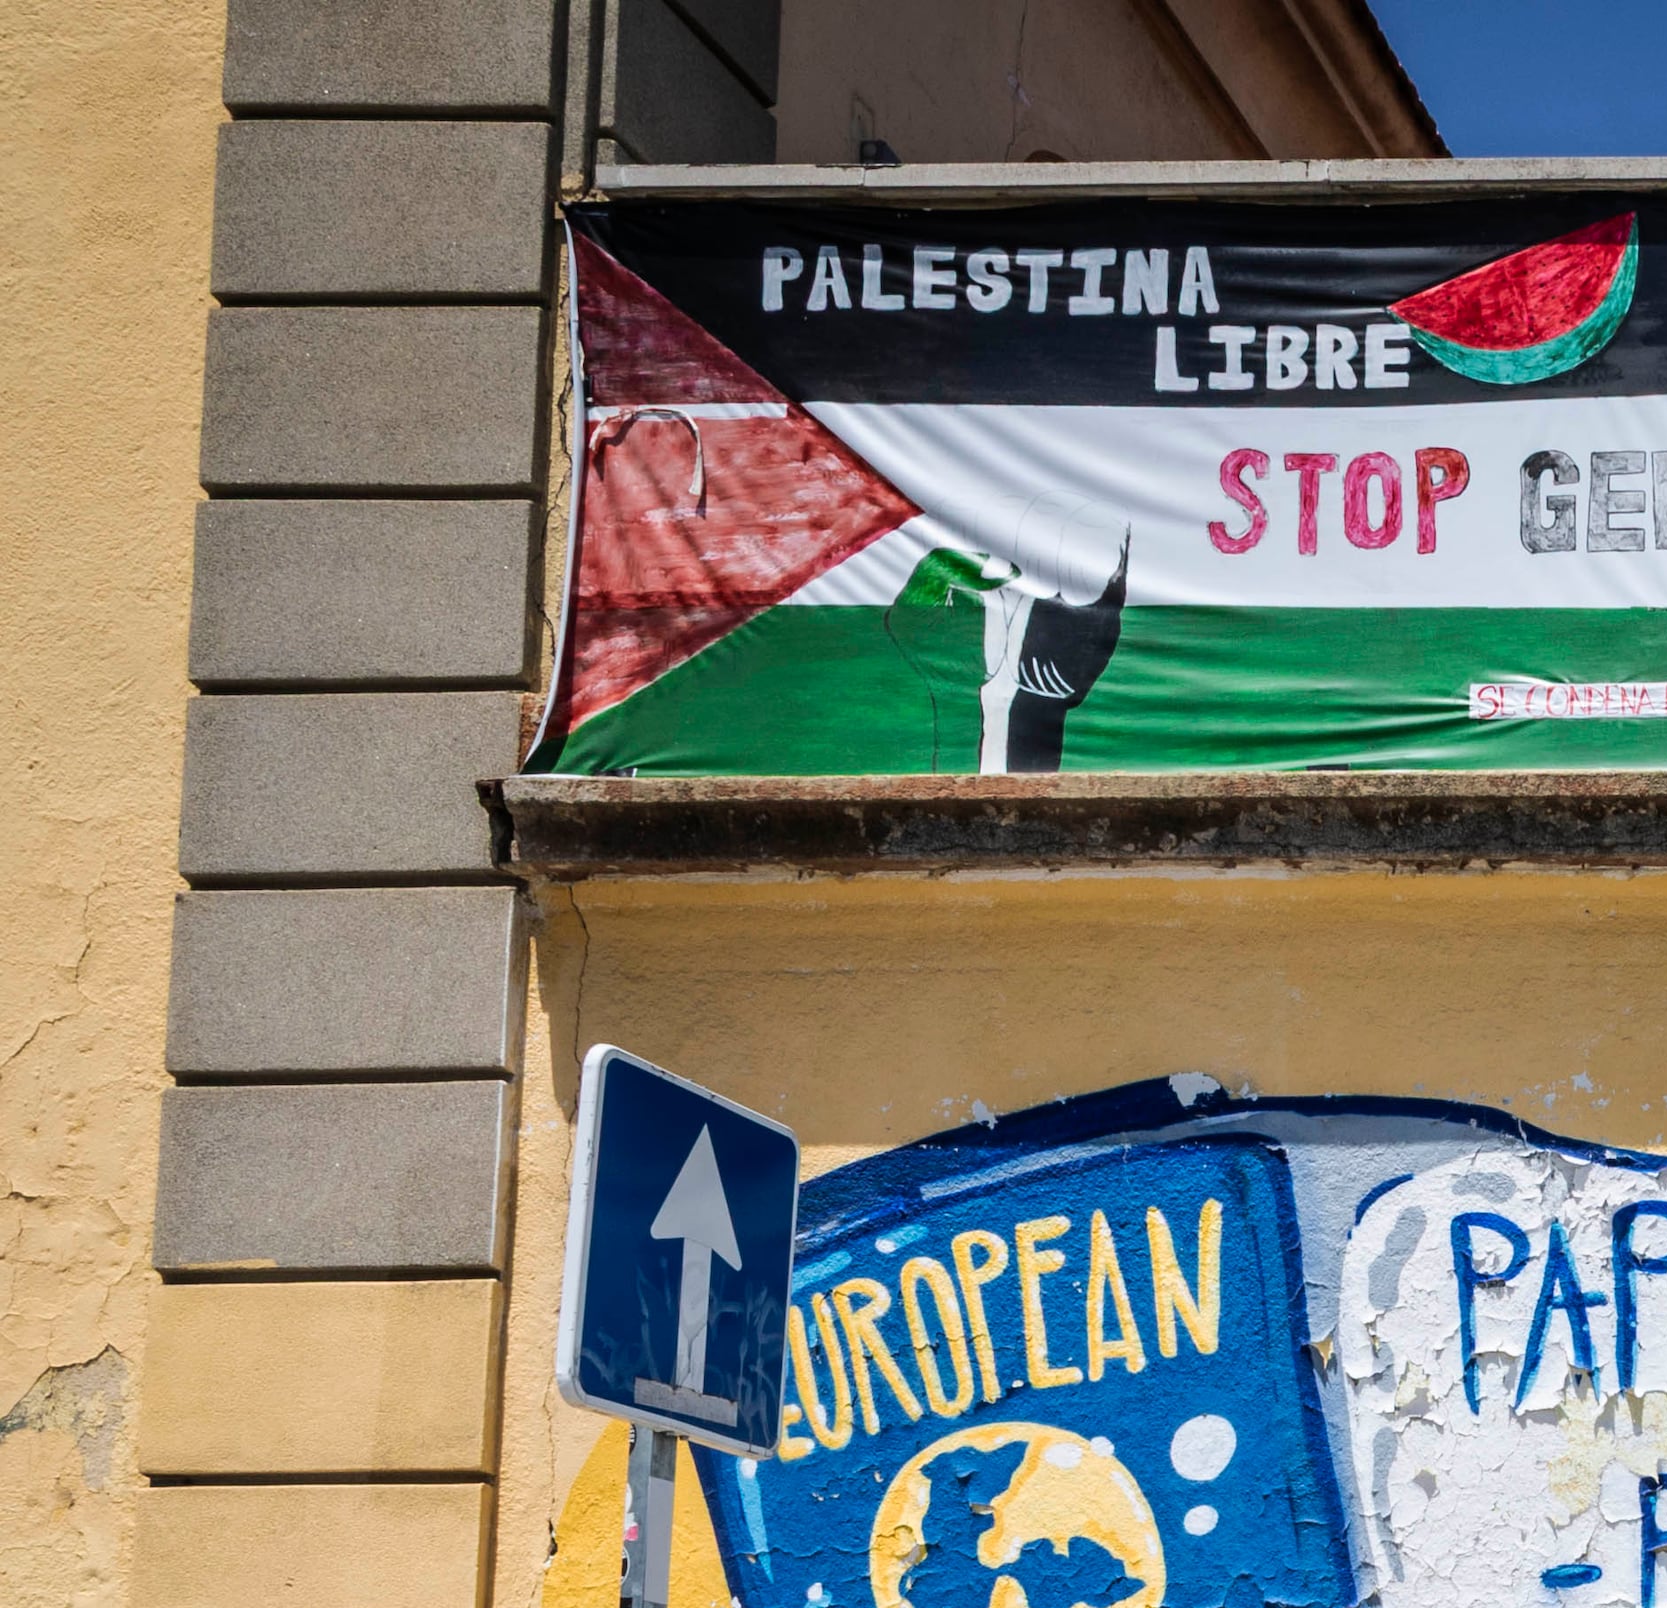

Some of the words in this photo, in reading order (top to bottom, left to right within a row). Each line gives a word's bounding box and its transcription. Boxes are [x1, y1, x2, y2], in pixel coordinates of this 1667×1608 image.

[761, 244, 1219, 316] PALESTINA
[1154, 323, 1411, 393] LIBRE
[1208, 447, 1469, 555] STOP
[1477, 685, 1515, 718] SE
[1525, 684, 1655, 716] CONDENA
[779, 1198, 1225, 1463] EUROPEAN
